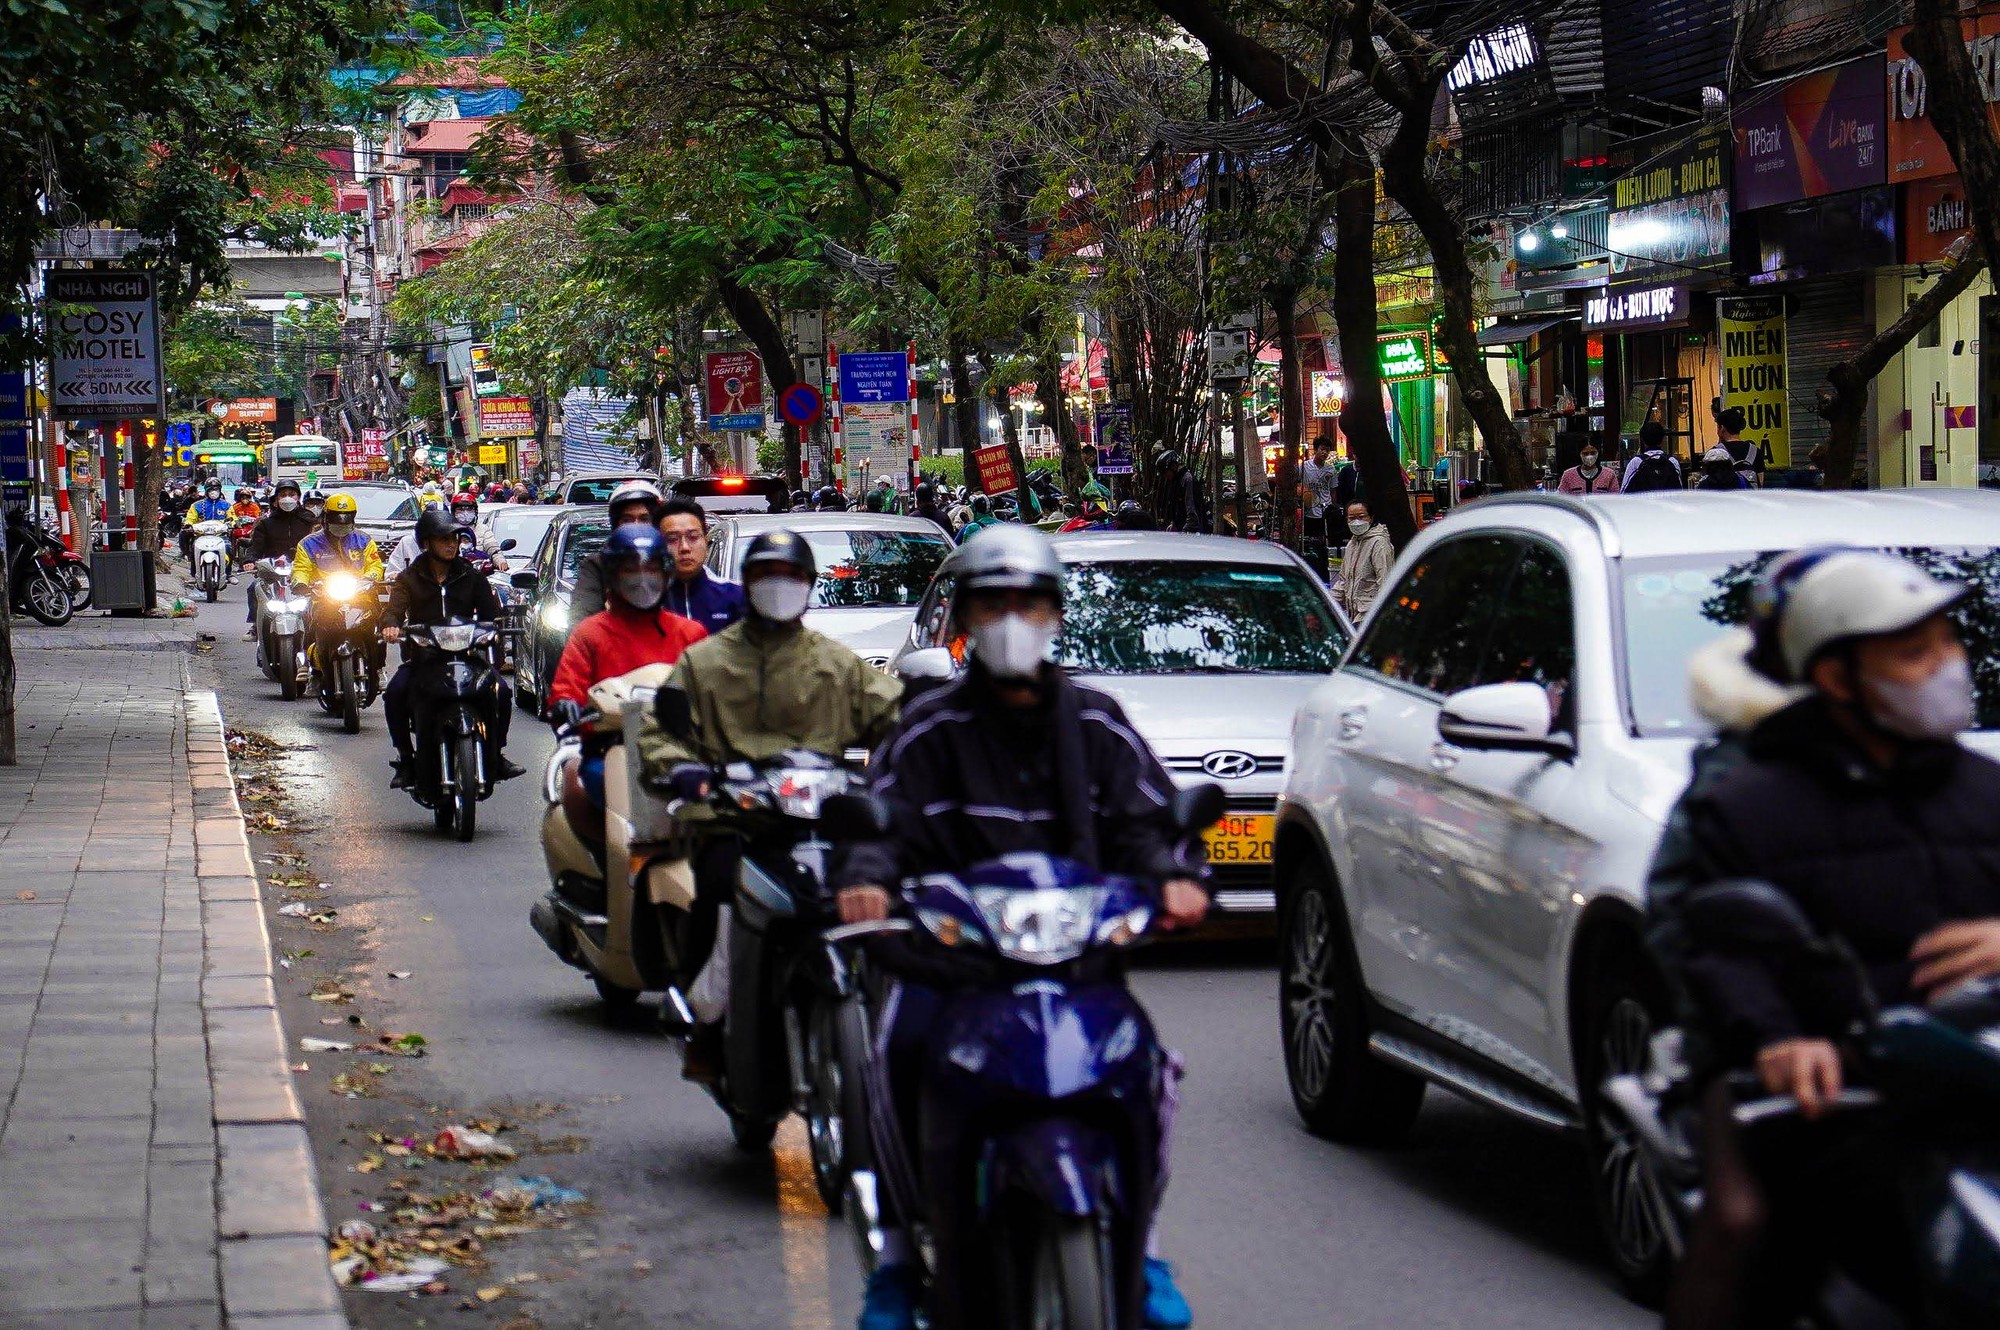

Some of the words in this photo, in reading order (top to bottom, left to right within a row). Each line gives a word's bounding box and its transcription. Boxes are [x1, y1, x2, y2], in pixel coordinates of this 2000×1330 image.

[1748, 123, 1782, 157] TPBank
[1828, 110, 1857, 150] Live
[1857, 123, 1875, 143] BANK
[1858, 145, 1874, 165] 24/7
[1681, 156, 1704, 194] BÚN
[1706, 149, 1721, 188] CÁ
[1927, 193, 1964, 233] BÁNH
[1587, 287, 1609, 324] PHỞ
[60, 311, 144, 335] COSY
[62, 339, 146, 360] MOTEL
[1385, 338, 1417, 358] NHÀ
[1725, 321, 1782, 357] MIẾN
[711, 366, 736, 376] LIGHT
[735, 364, 754, 373] BOX
[1381, 354, 1425, 377] THUỐC
[90, 382, 122, 395] 50M
[1726, 363, 1783, 393] LƯƠN
[229, 402, 257, 410] MAISON
[238, 410, 265, 418] BUFFET
